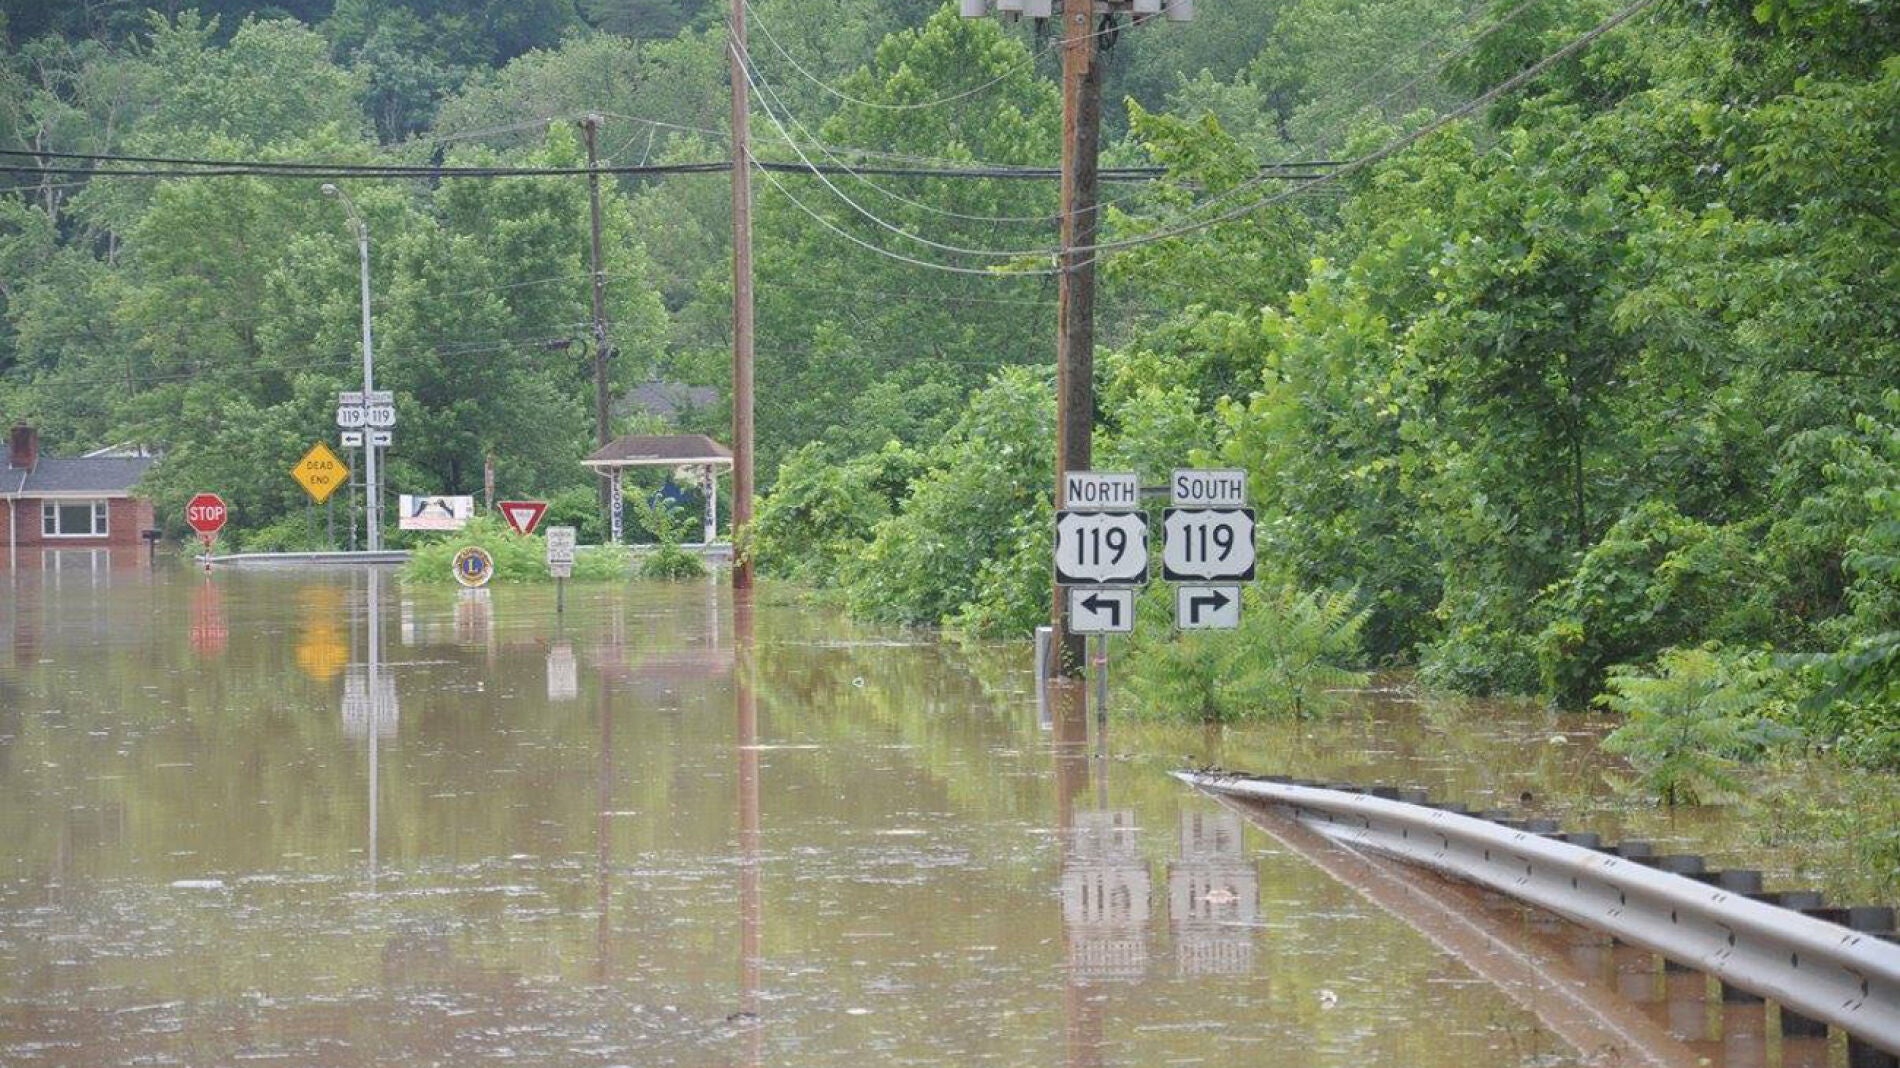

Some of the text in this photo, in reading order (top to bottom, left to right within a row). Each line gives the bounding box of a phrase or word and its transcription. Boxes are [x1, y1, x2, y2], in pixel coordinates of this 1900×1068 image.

[342, 410, 360, 422] 119
[373, 409, 389, 422] 119
[306, 461, 333, 470] DEAD
[310, 475, 329, 484] END
[1177, 475, 1242, 499] SOUTH
[1068, 478, 1134, 502] NORTH
[190, 506, 223, 521] STOP
[1075, 526, 1128, 565] 119
[1183, 523, 1235, 562] 119
